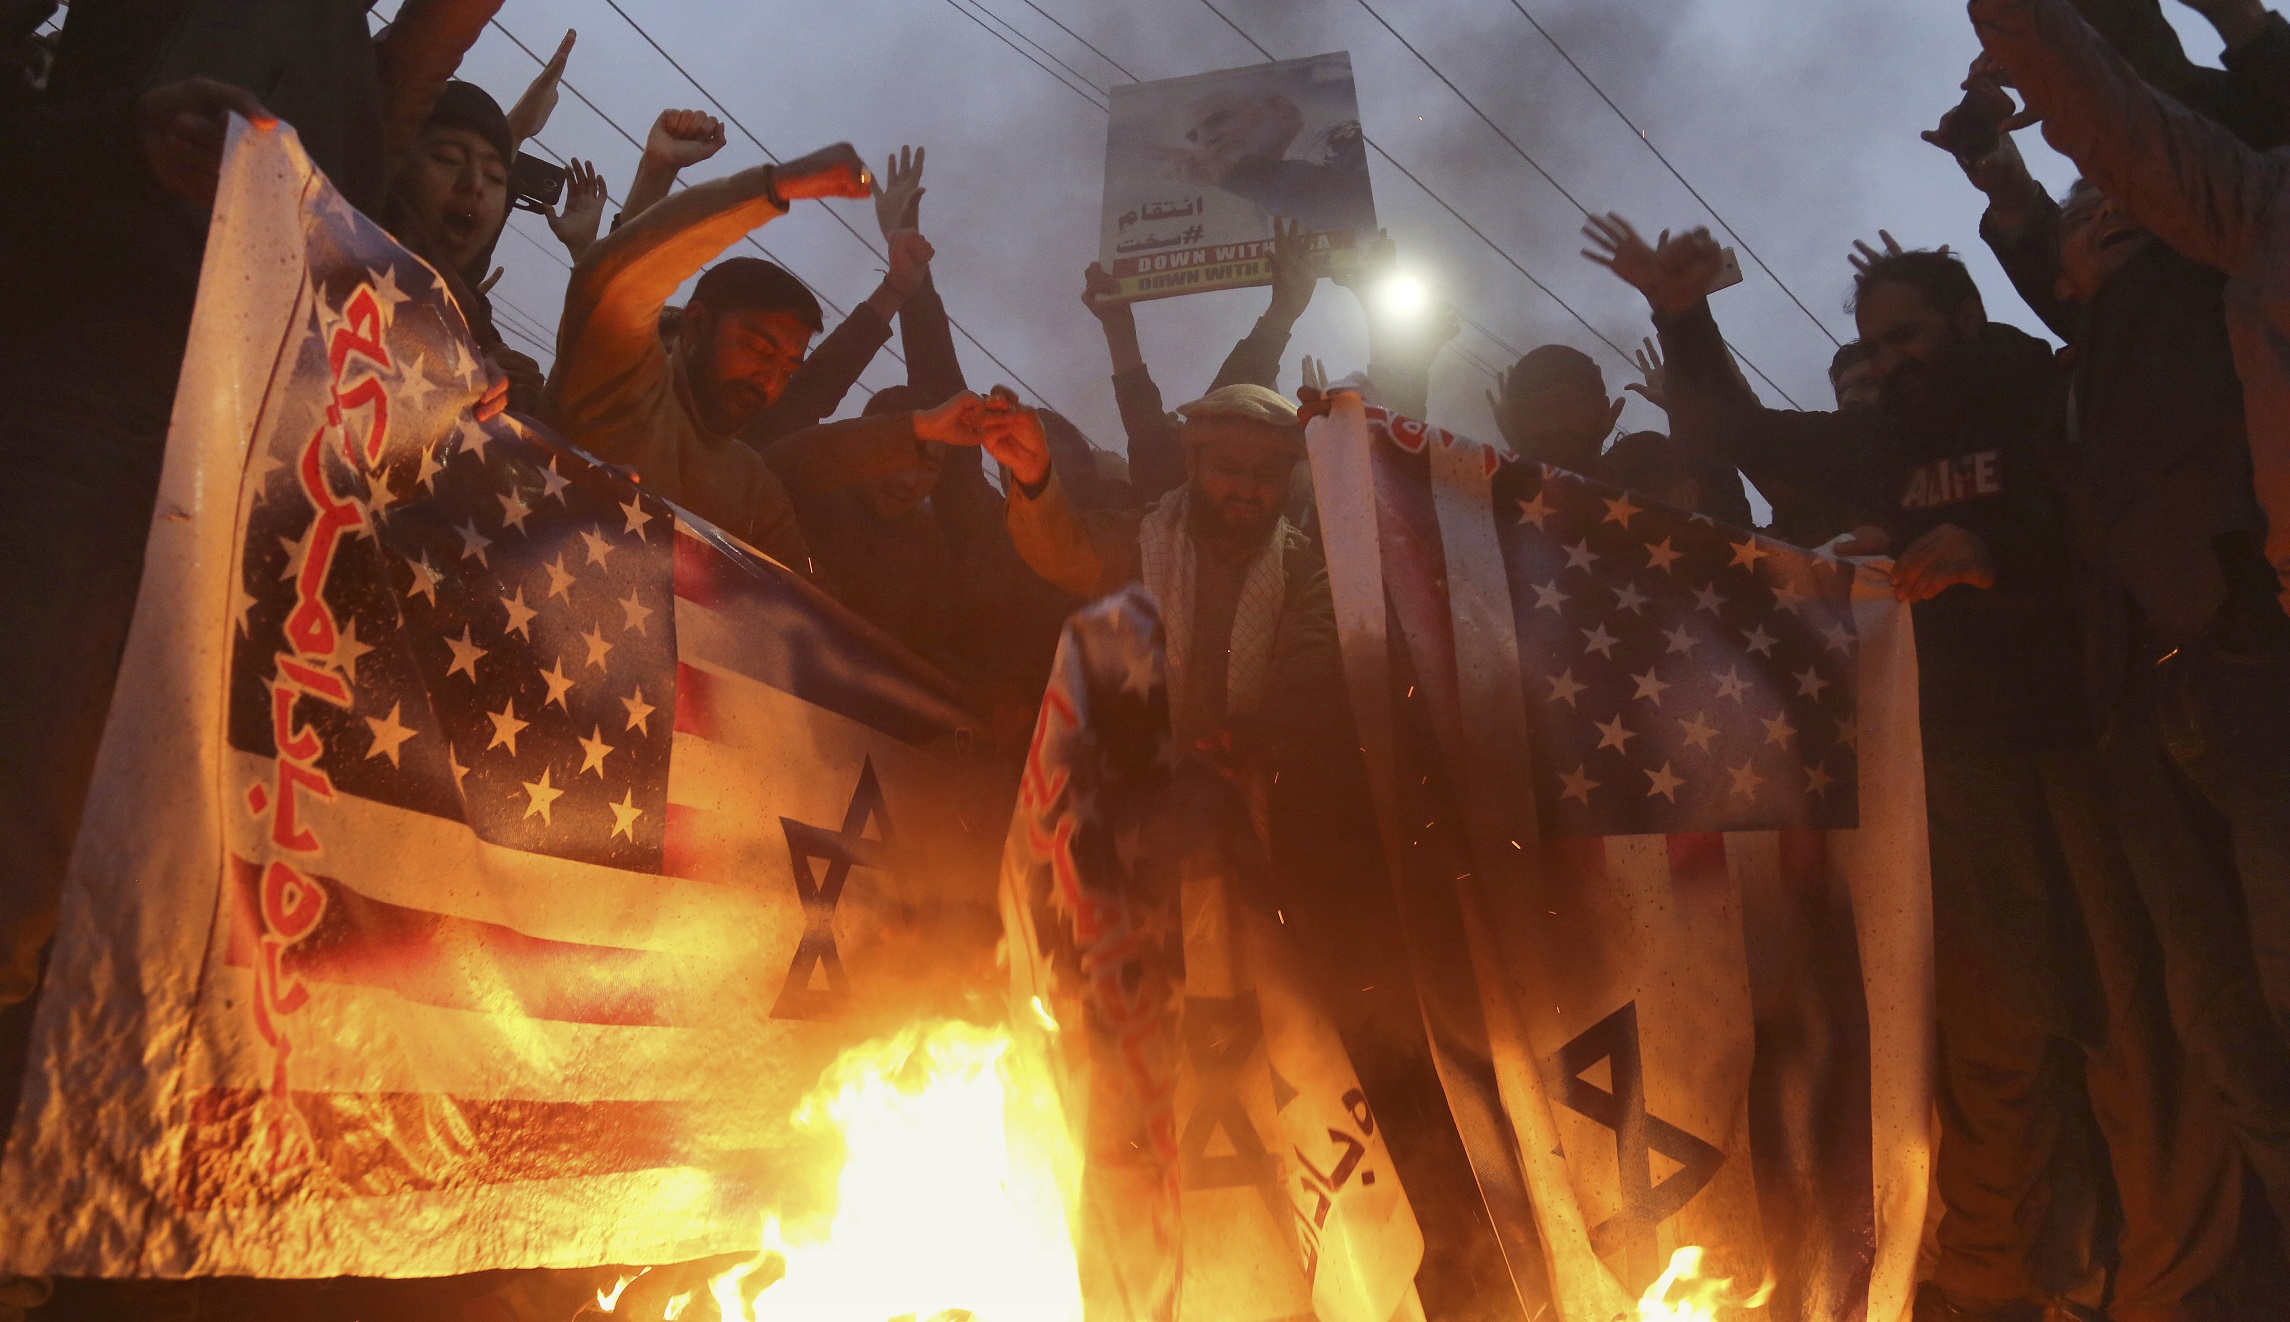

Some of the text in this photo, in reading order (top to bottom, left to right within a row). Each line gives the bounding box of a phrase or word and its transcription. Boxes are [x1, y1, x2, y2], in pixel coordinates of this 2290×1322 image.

[1118, 197, 1204, 230] انتقام
[1137, 242, 1276, 272] DOWN WITH
[1138, 270, 1200, 291] DOWN
[1205, 262, 1258, 282] WITH
